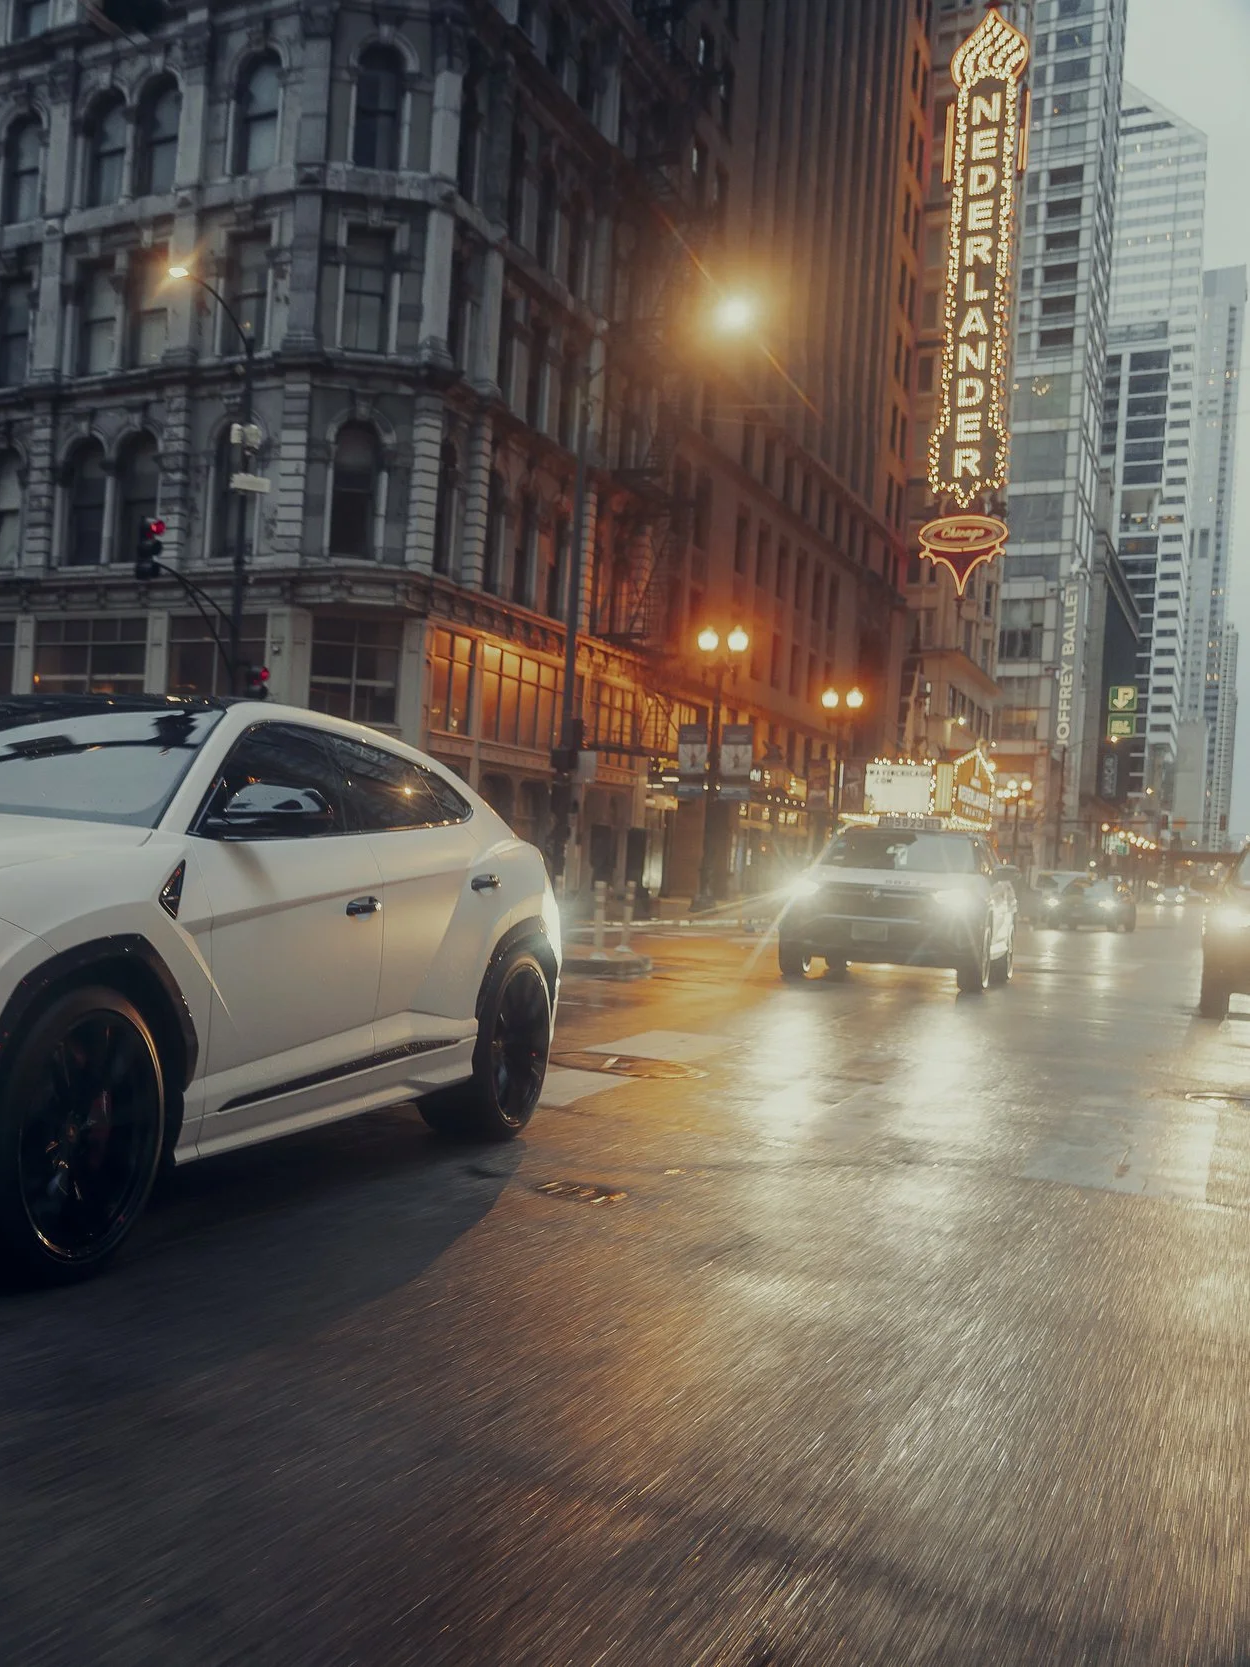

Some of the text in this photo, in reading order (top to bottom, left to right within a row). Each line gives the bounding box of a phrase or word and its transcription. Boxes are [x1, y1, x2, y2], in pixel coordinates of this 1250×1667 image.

[953, 92, 1002, 479] NEDERLANDER
[1056, 583, 1079, 745] JOFFREY BALLET
